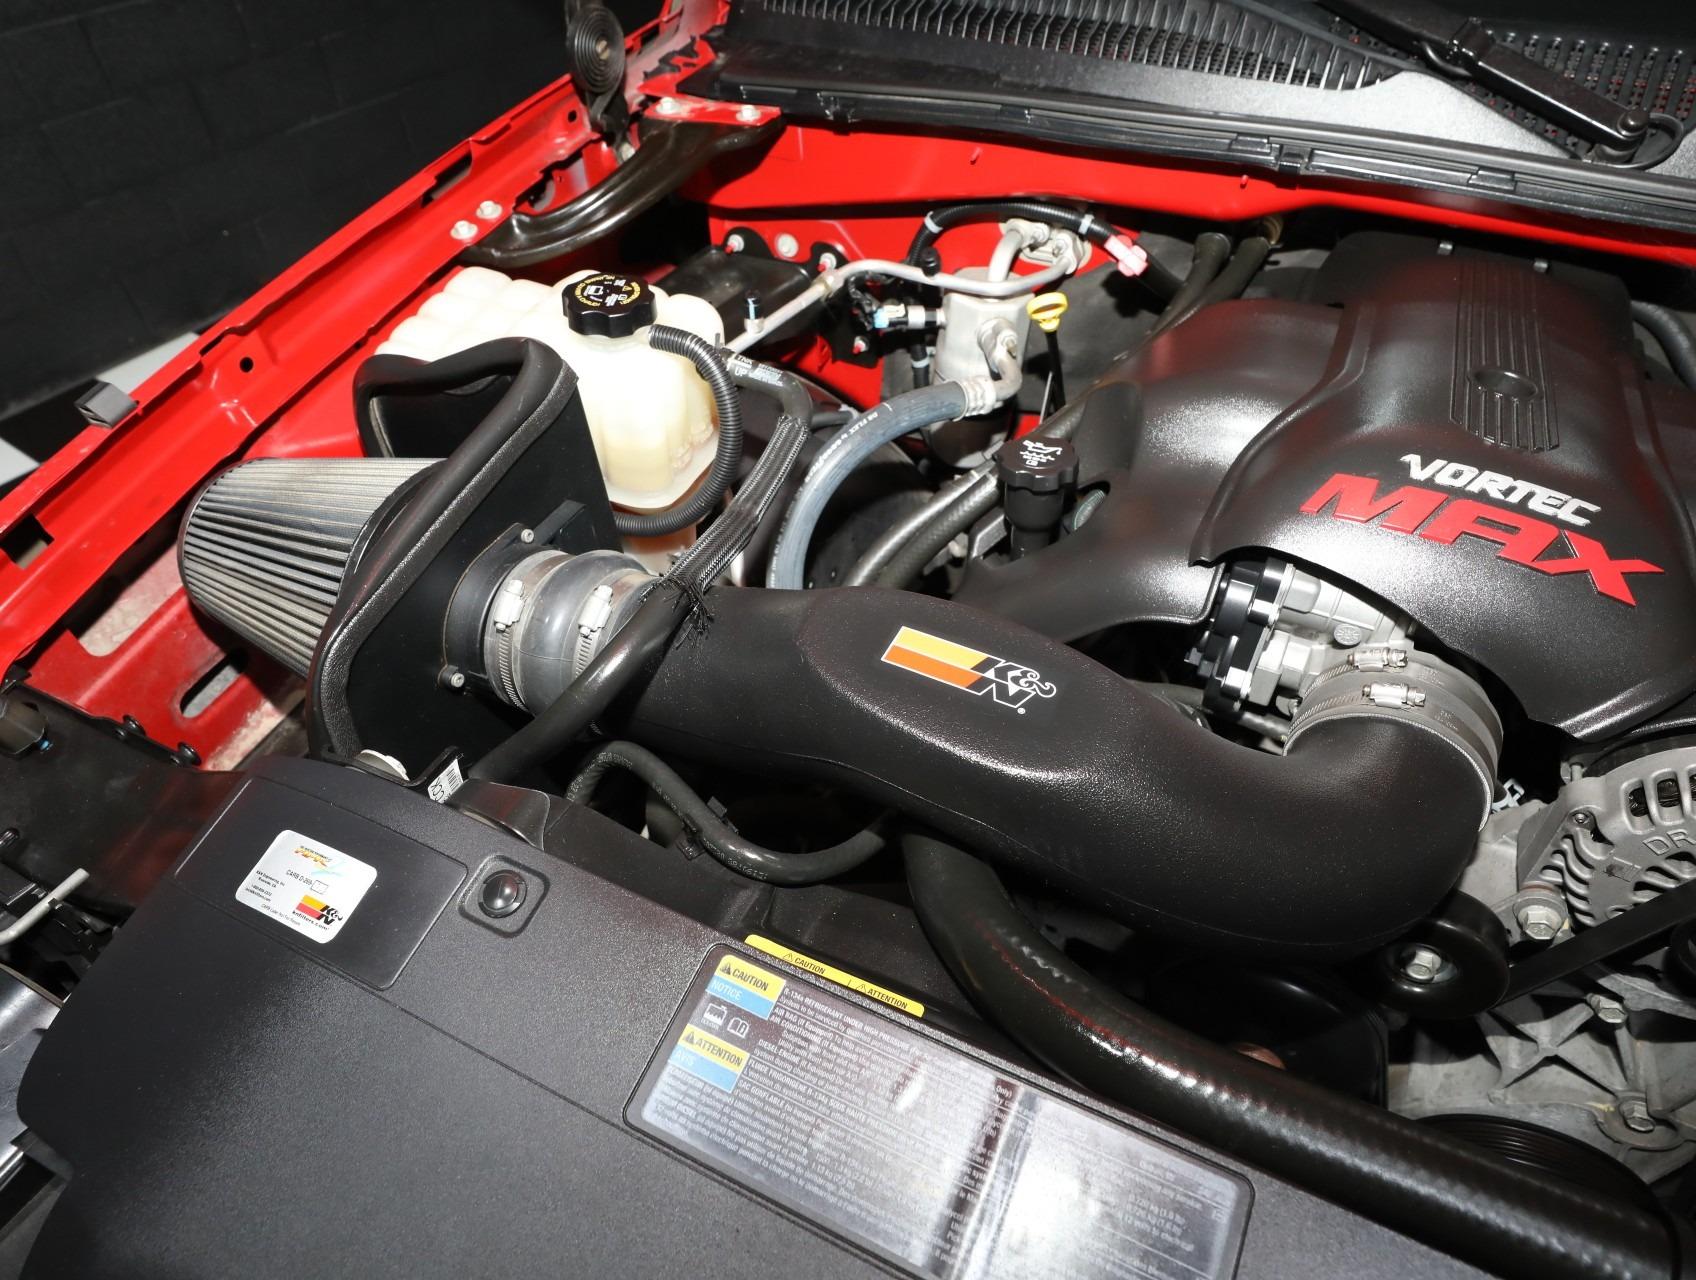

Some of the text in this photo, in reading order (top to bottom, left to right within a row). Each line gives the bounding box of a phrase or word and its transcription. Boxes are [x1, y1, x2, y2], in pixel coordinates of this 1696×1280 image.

[734, 365, 749, 378] UP
[848, 418, 868, 433] FLEX
[1400, 453, 1601, 527] VORTEC
[1300, 473, 1664, 607] MAX
[794, 956, 826, 975] CAUTION
[711, 980, 743, 1000] NOTICE
[732, 968, 769, 991] CAUTION
[867, 988, 908, 1009] ATTENTION
[696, 1038, 743, 1067] ATTENTION
